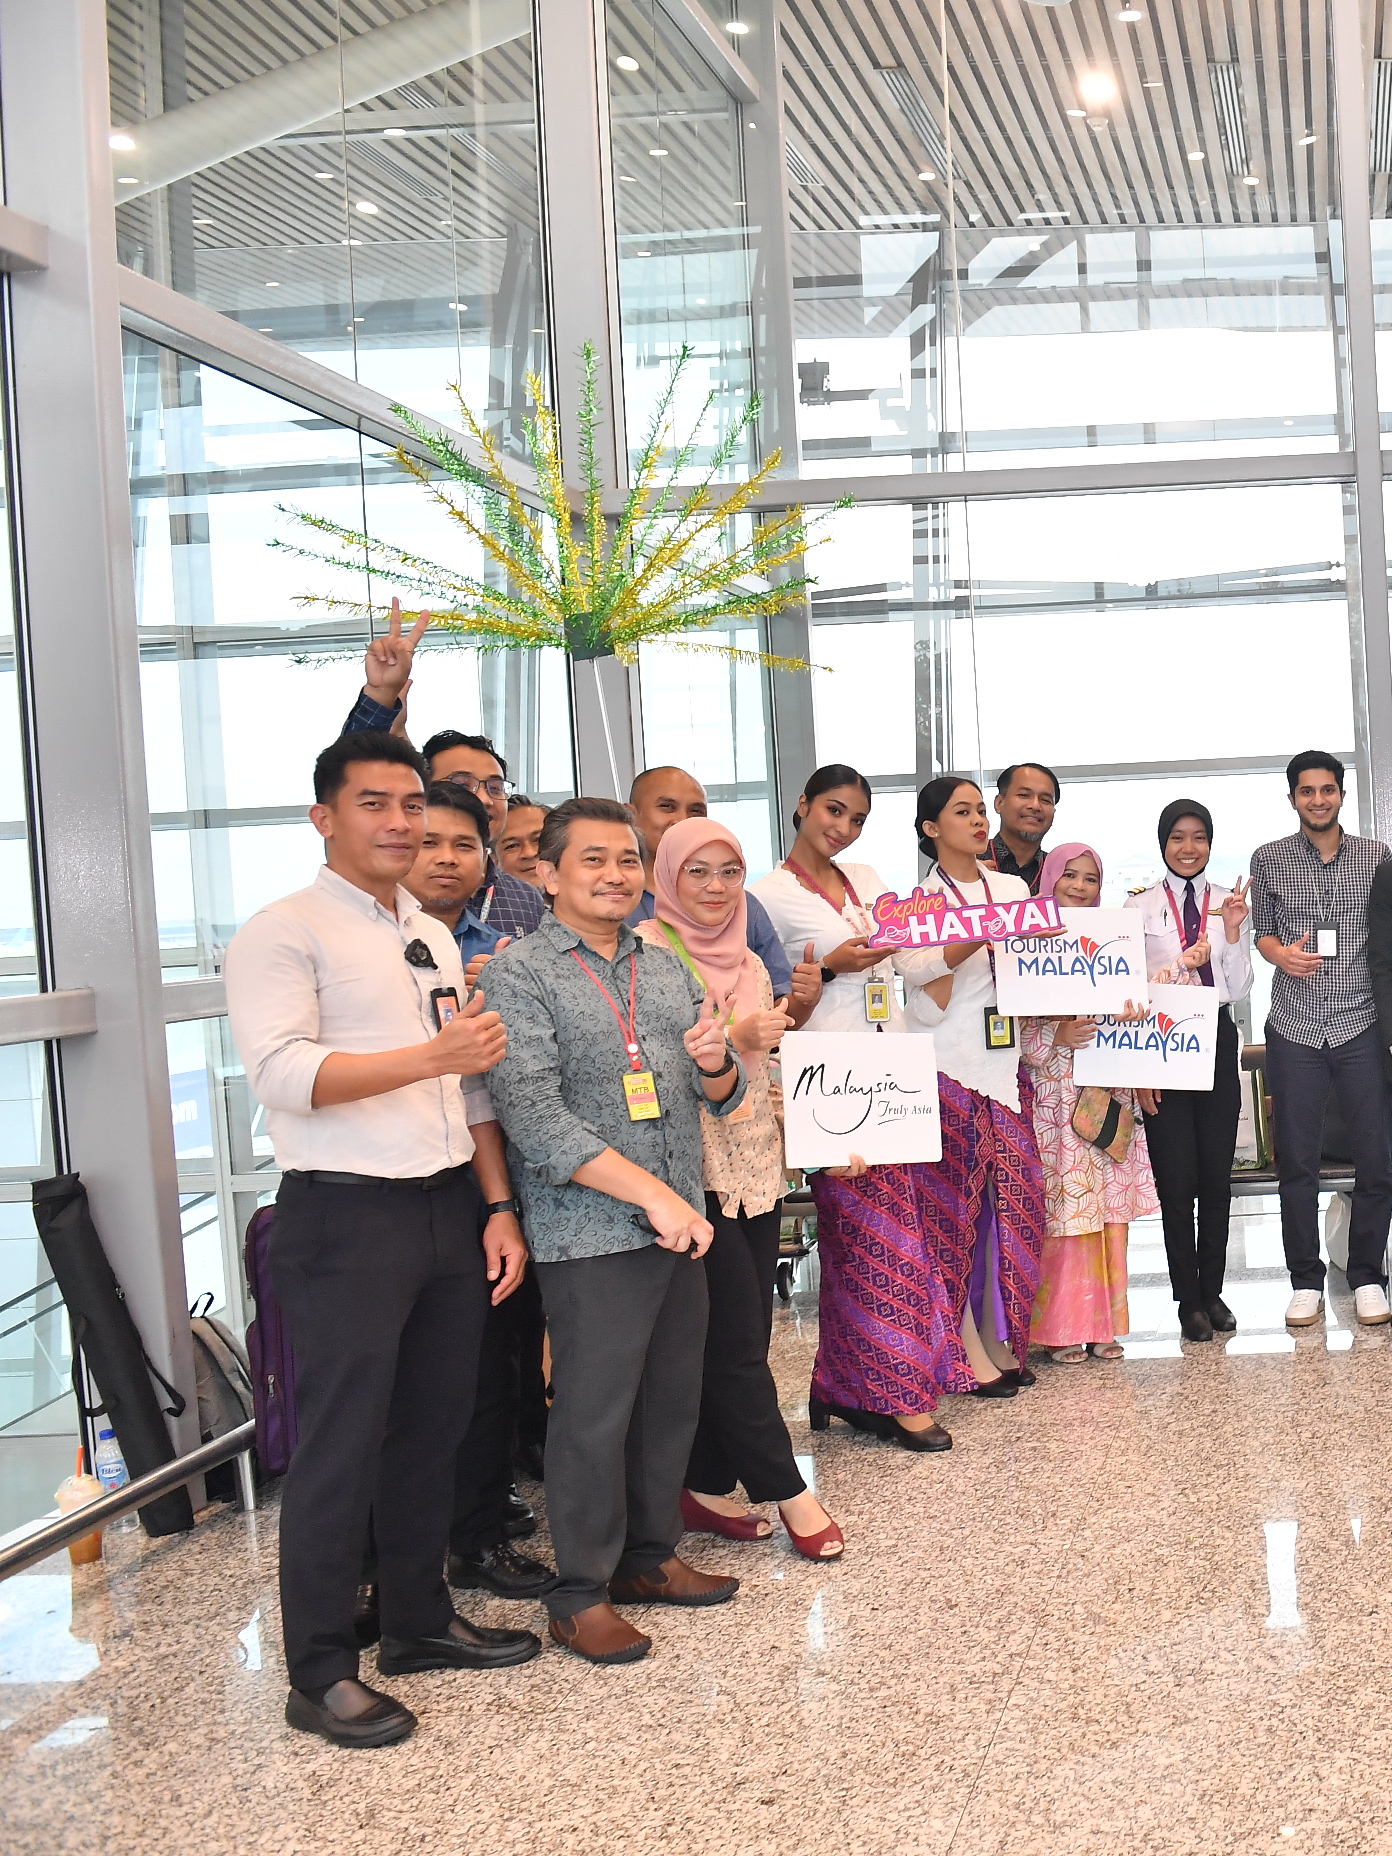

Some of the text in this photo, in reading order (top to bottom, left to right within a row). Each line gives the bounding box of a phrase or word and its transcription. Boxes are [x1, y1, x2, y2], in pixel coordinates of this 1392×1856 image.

[876, 892, 945, 926] Explore
[909, 908, 988, 944] HAT
[1001, 901, 1060, 933] YAI
[1005, 938, 1079, 954] TOURISM
[1018, 956, 1130, 987] MALAYSIA
[1096, 1030, 1200, 1062] MALAYSIA
[631, 1086, 650, 1095] MTB
[793, 1063, 921, 1135] Malaysia
[877, 1100, 932, 1117] Truly Asia
